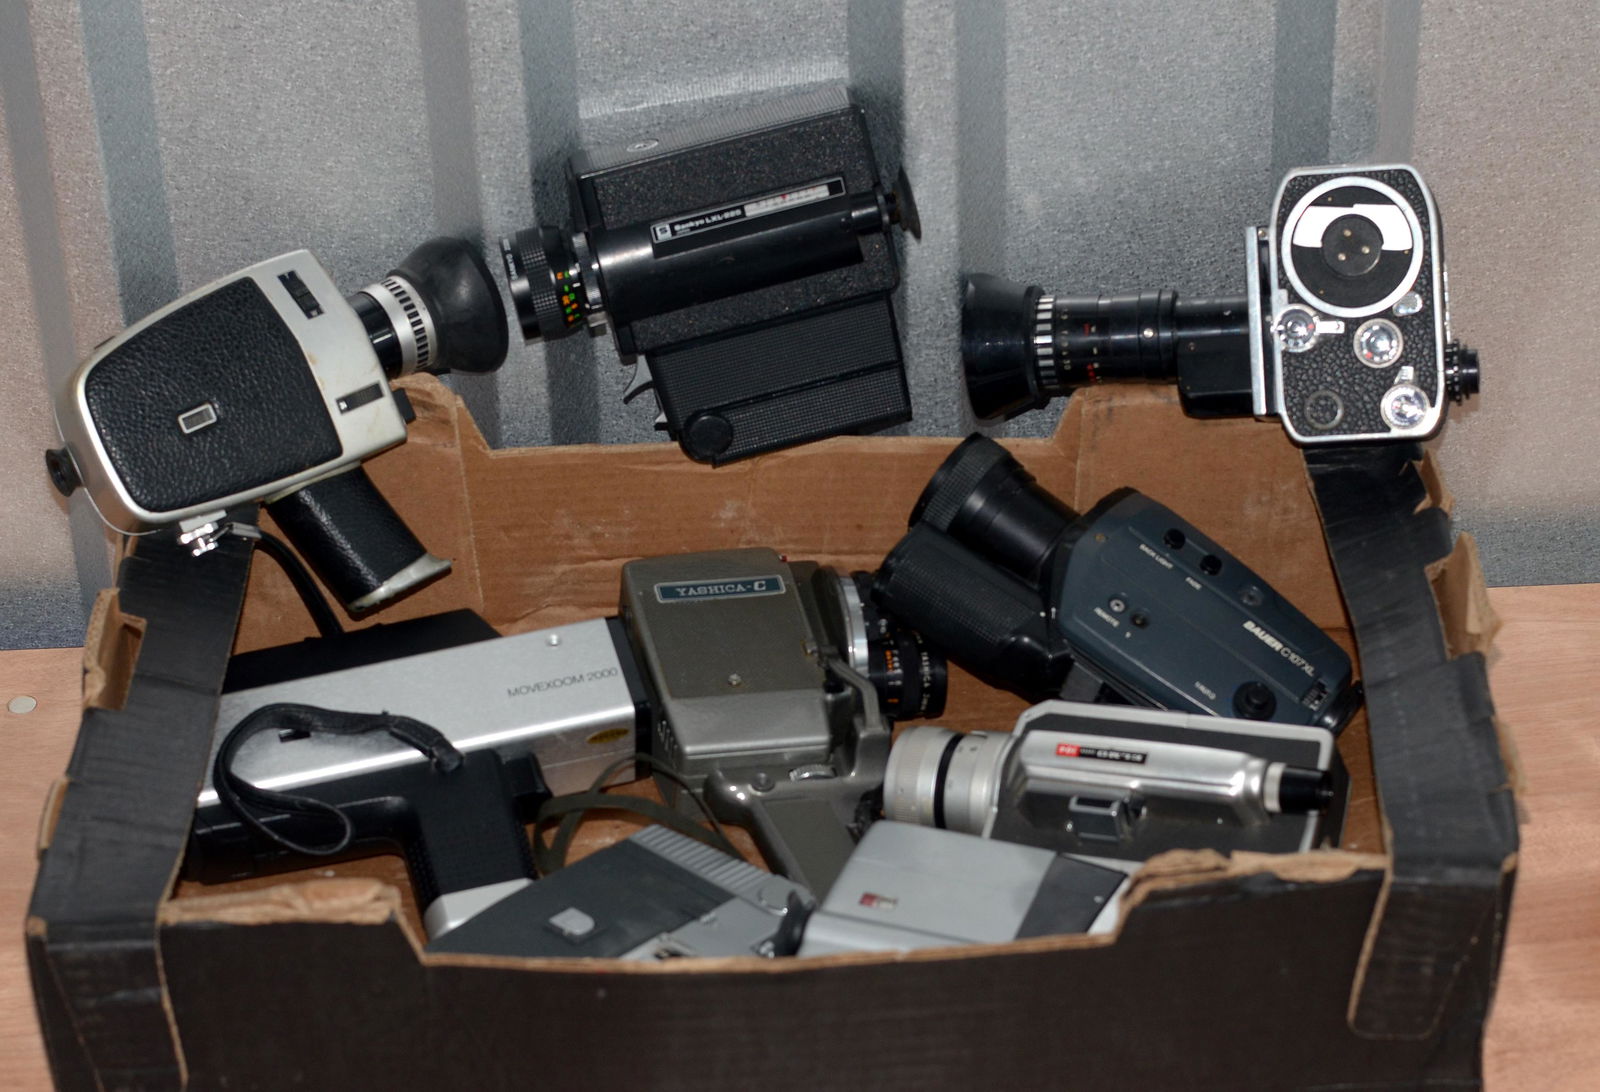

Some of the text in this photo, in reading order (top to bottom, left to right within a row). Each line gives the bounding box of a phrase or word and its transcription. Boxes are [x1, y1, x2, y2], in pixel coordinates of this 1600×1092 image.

[675, 580, 768, 597] YASHICA-C
[1242, 619, 1284, 653] BAUER
[507, 666, 618, 699] MOVEXOOM 2000
